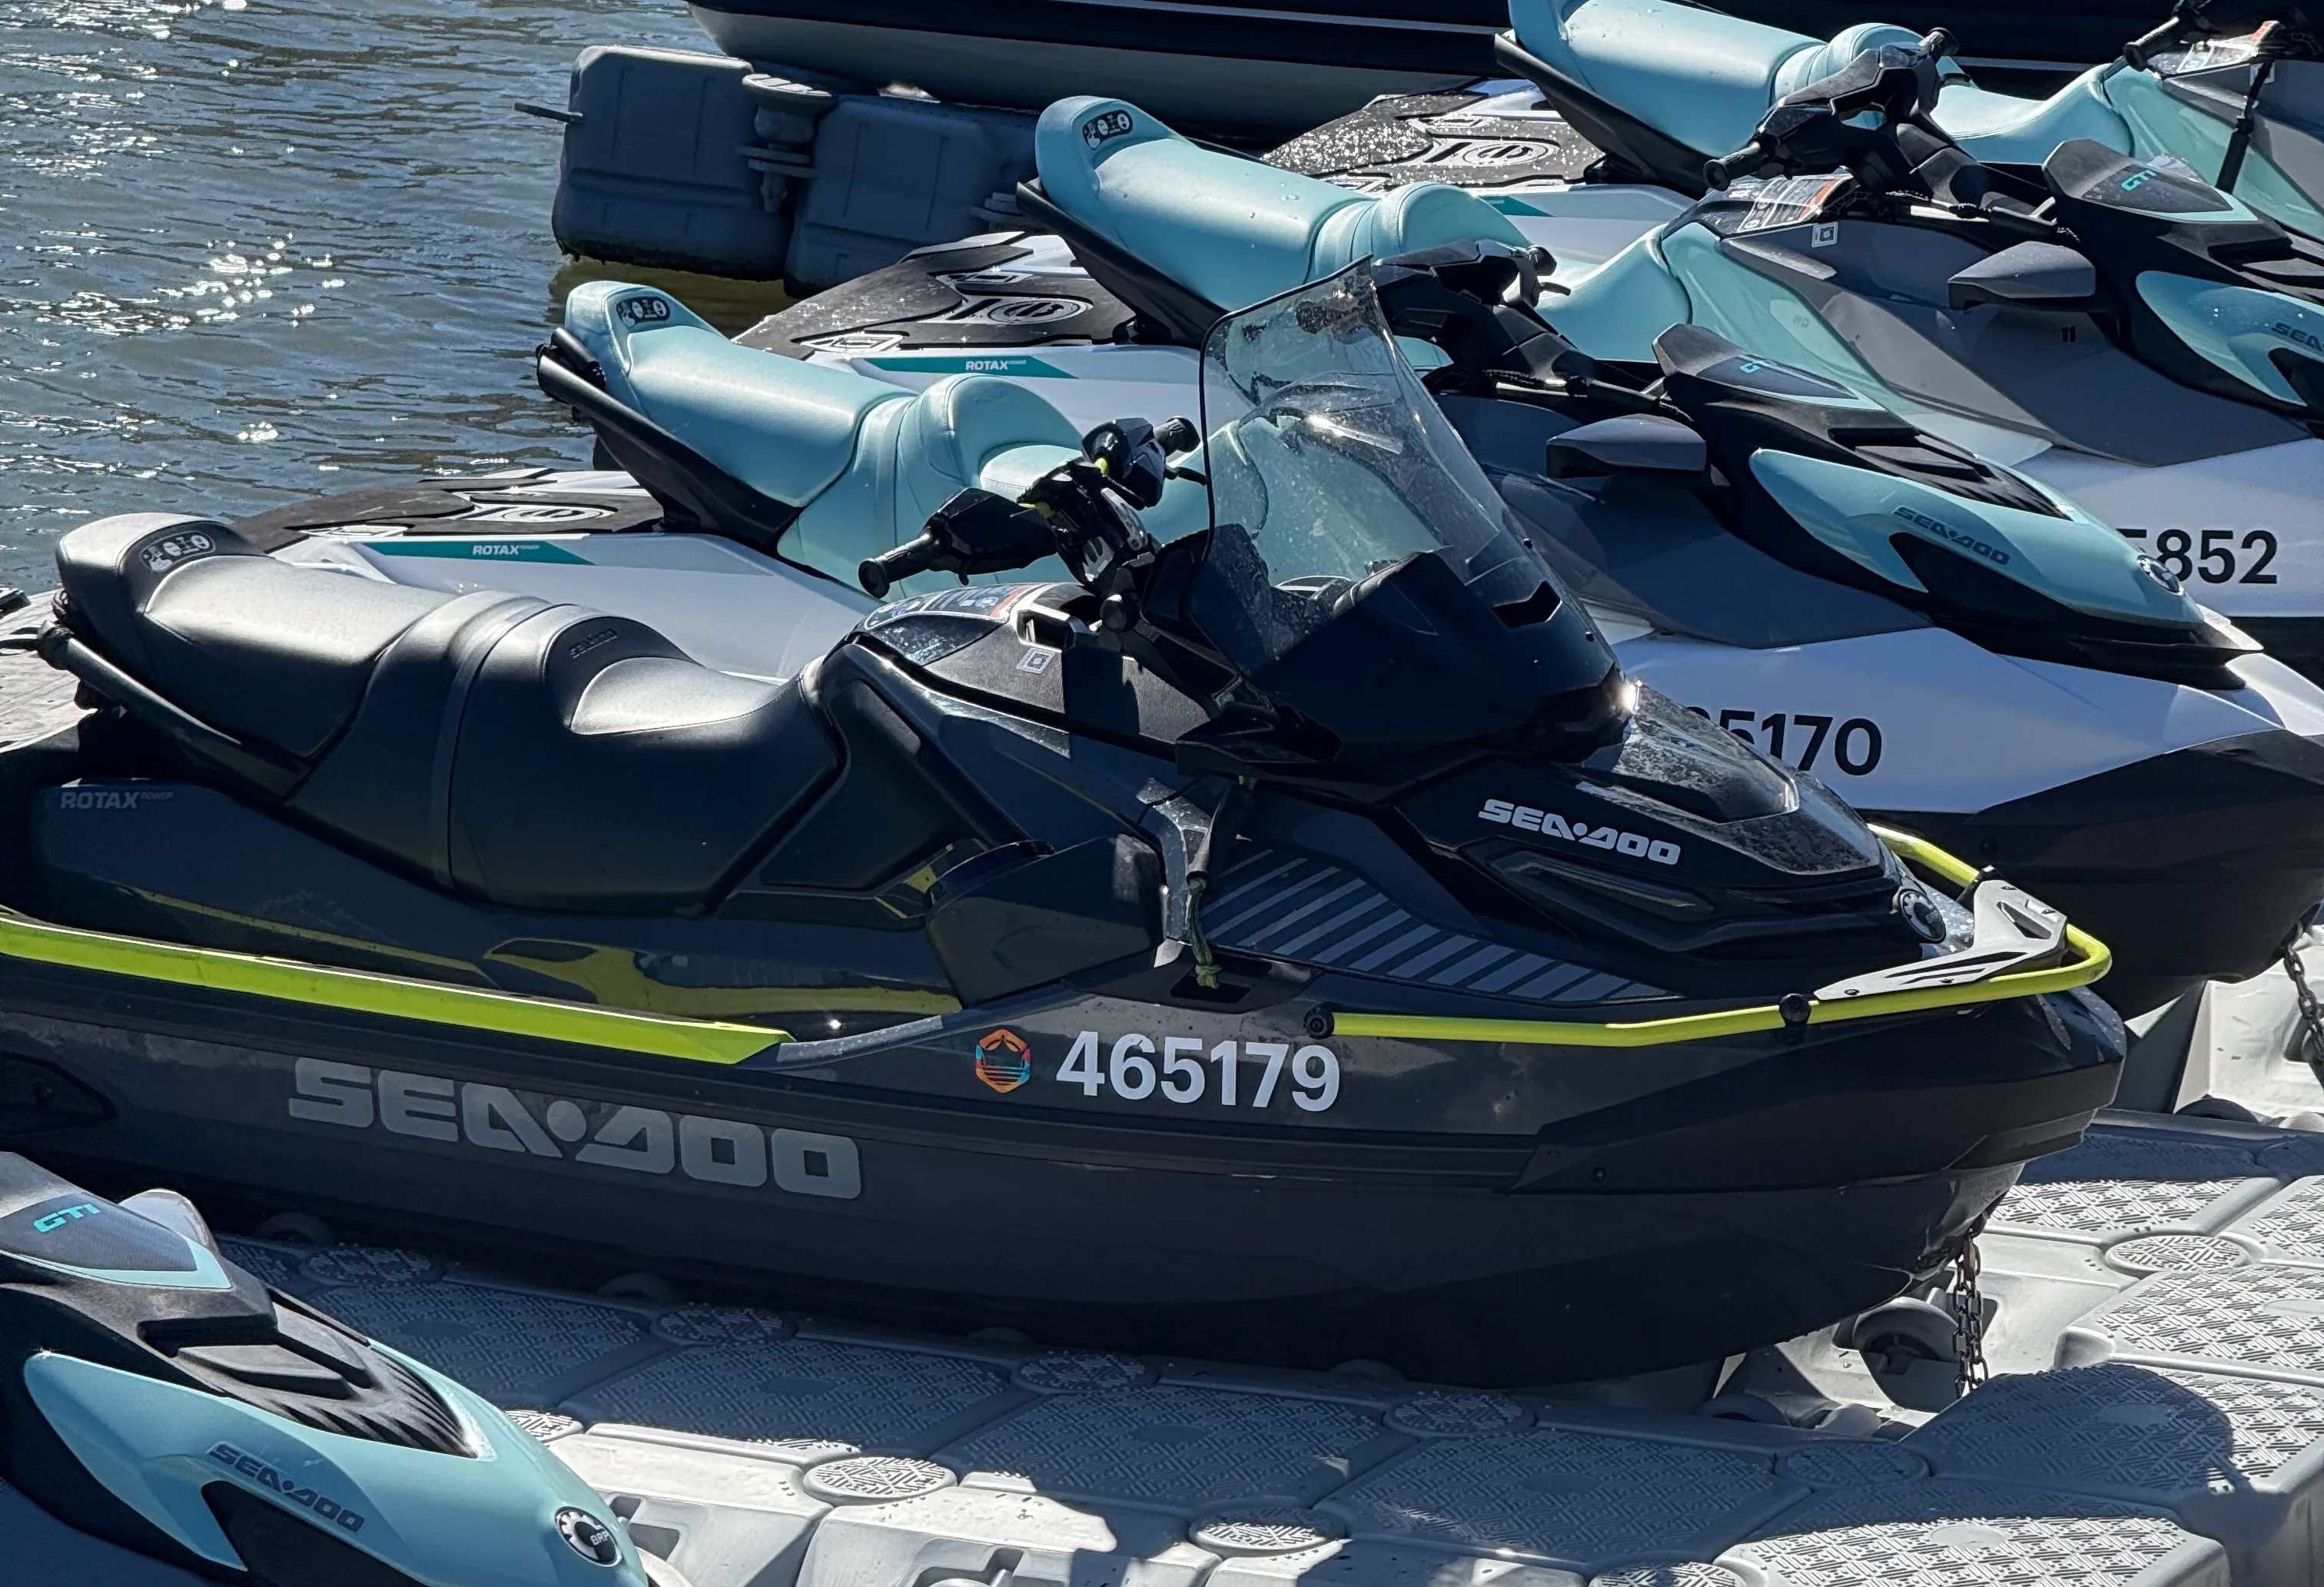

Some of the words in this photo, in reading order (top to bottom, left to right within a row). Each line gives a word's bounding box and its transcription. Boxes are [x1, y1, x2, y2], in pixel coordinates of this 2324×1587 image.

[965, 360, 1008, 370] ROTAX
[472, 545, 520, 556] ROTAX
[2116, 529, 2278, 584] 852
[1687, 706, 1882, 776] 5170
[60, 792, 139, 809] ROTAX
[1056, 1031, 1340, 1112] 465179
[33, 1204, 101, 1233] GTI
[589, 1530, 609, 1546] BRP
